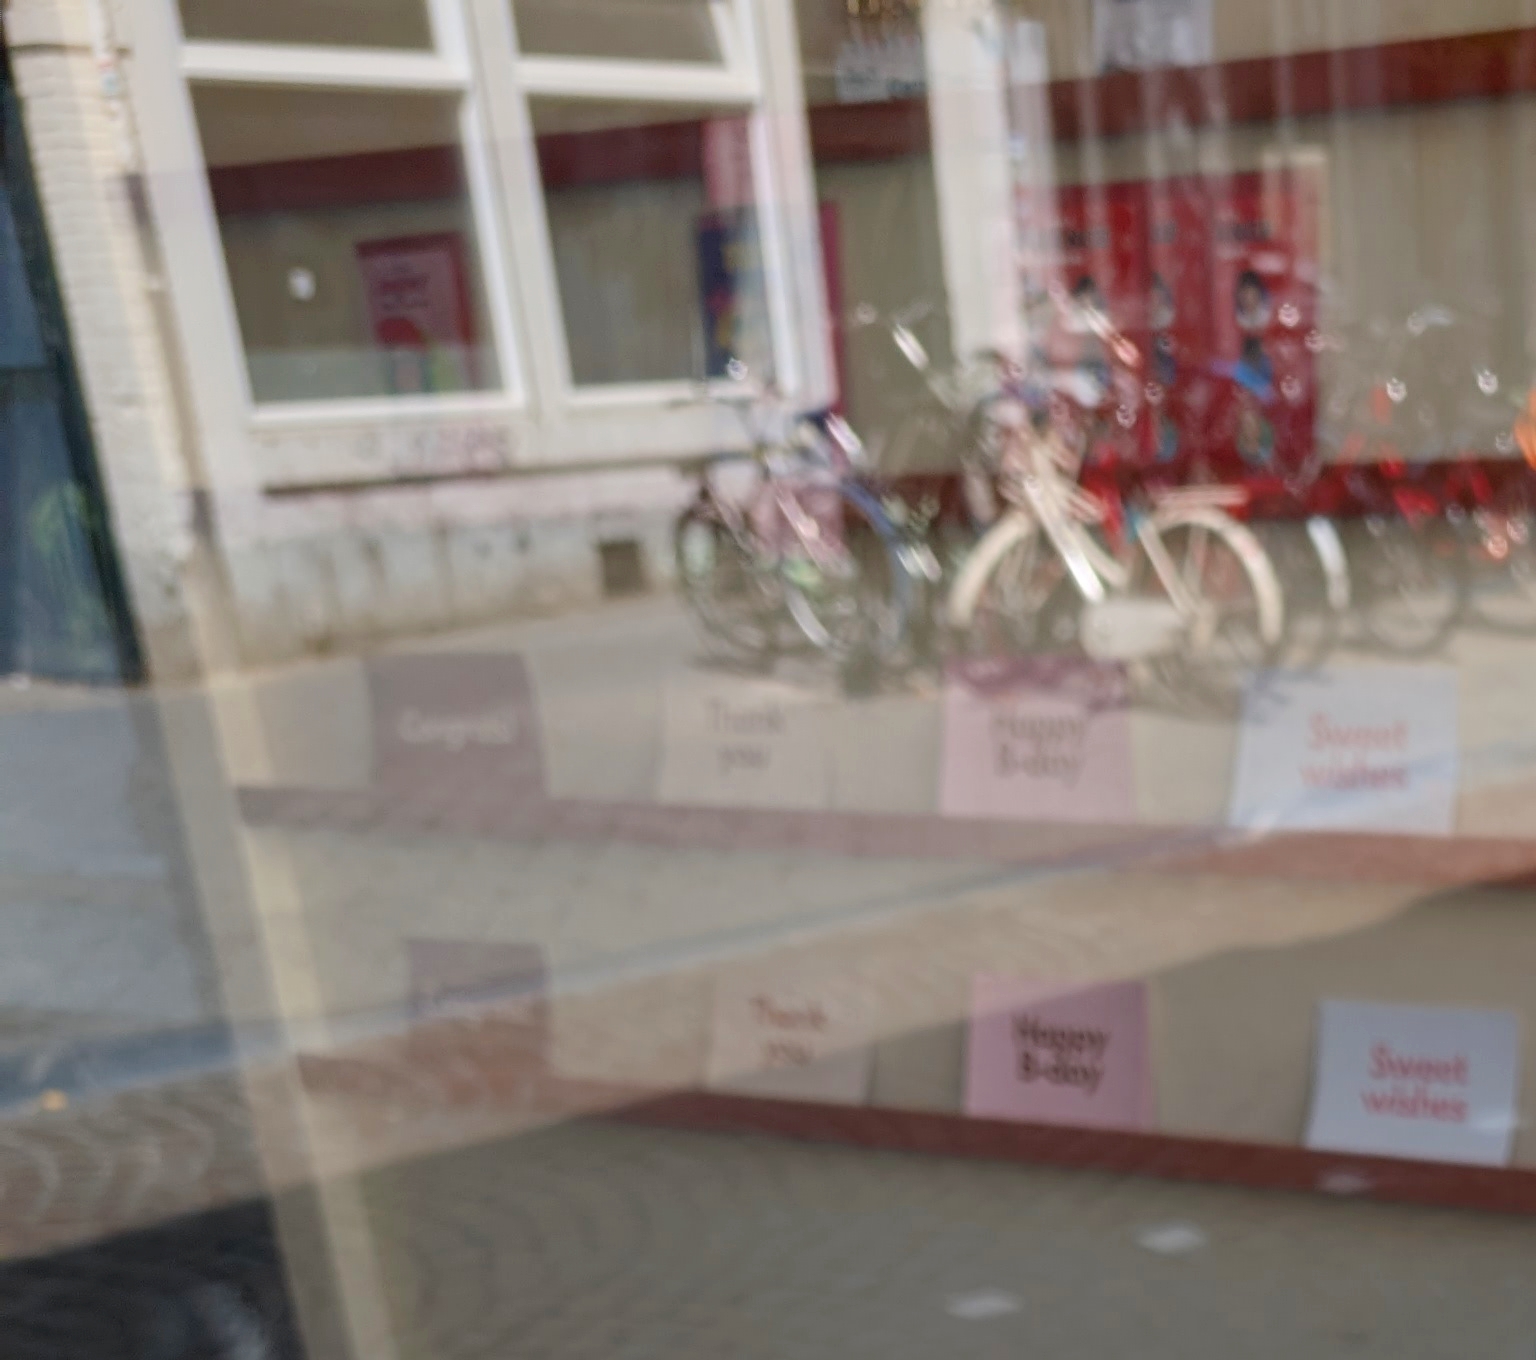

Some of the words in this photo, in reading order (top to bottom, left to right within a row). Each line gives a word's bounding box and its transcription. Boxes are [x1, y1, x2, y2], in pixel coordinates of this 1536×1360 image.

[1306, 711, 1408, 753] Sweet
[1299, 751, 1409, 793] wishes
[1012, 1012, 1110, 1056] Happy
[1015, 1052, 1105, 1098] B-day
[1368, 1043, 1469, 1087] Sweet
[1360, 1087, 1467, 1125] wishes
